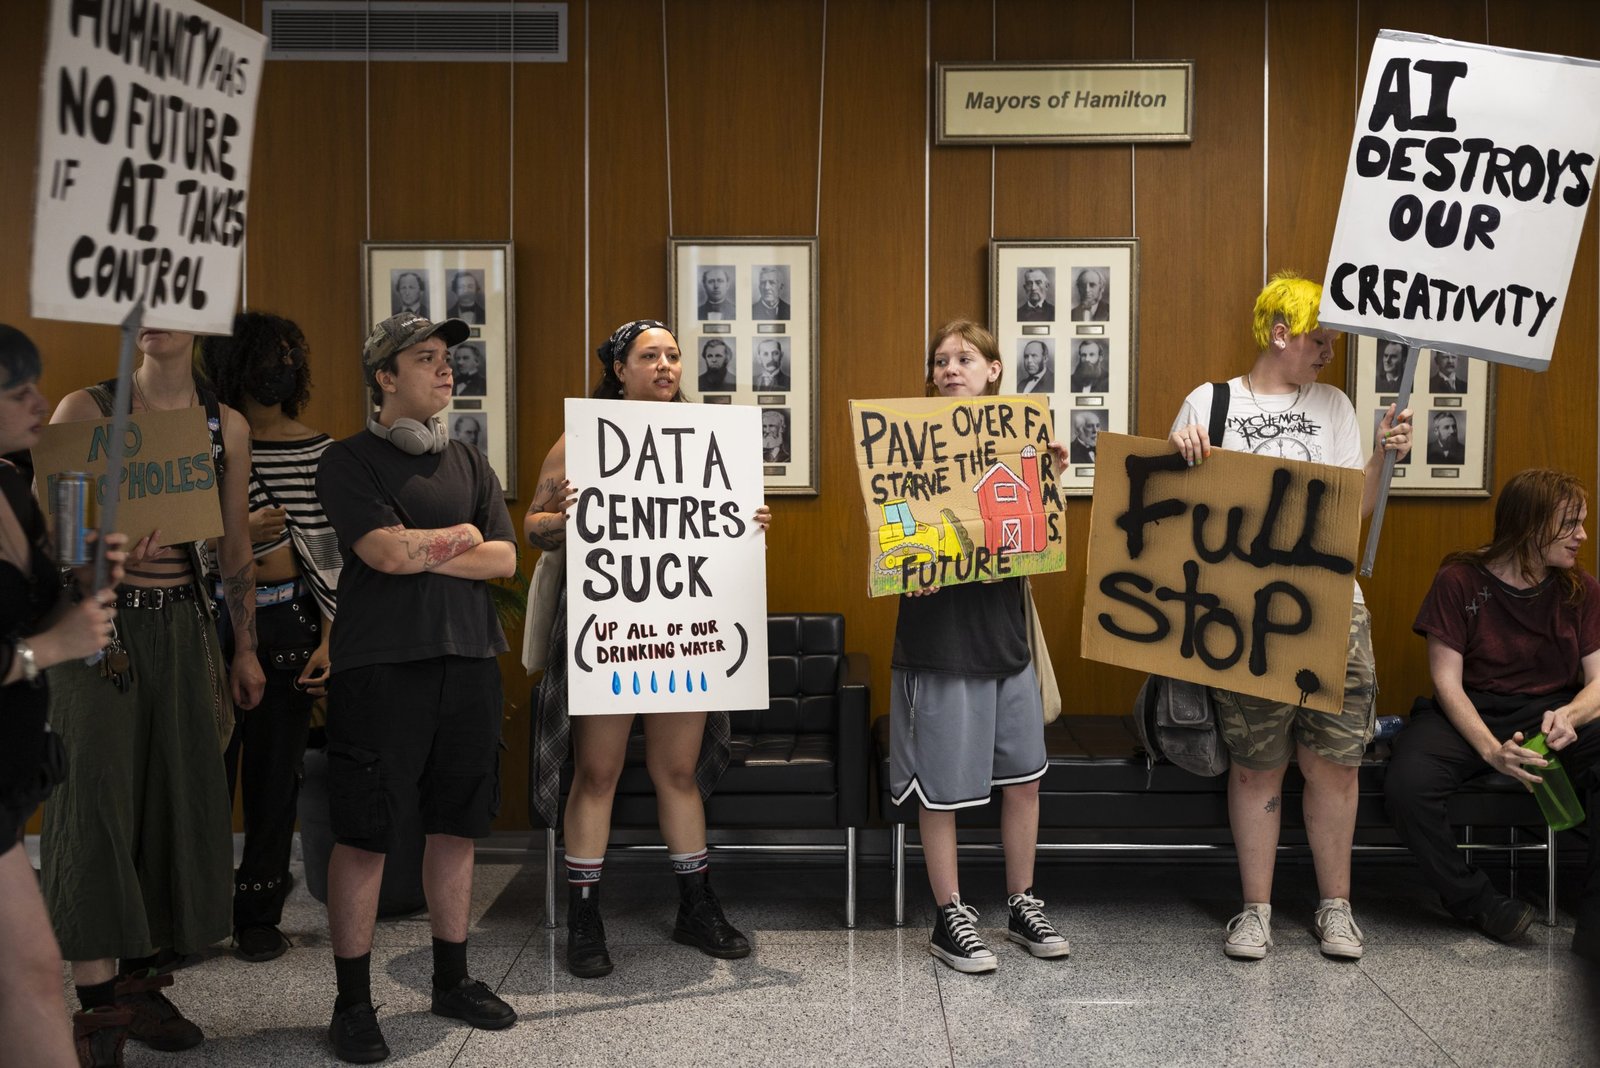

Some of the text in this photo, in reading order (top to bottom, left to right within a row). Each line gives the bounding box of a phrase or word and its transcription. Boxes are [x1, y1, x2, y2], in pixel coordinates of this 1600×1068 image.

[209, 47, 249, 97] HAS
[1368, 57, 1468, 132] AI
[59, 66, 239, 181] NO FUTURE
[965, 90, 1167, 113] Mayors of Hamilton
[51, 159, 80, 200] IF
[108, 157, 166, 241] AI
[1356, 135, 1595, 207] DESTROYS
[1389, 194, 1501, 251] OUR
[68, 235, 208, 310] CONTROL
[1330, 262, 1557, 337] CREATIVITY
[87, 422, 143, 462] NO
[597, 417, 732, 491] DATA
[860, 411, 949, 469] PAVE
[952, 404, 1017, 439] OVER
[1228, 417, 1250, 434] MY
[871, 440, 998, 505] STARVE THE
[576, 487, 746, 543] CENTRES
[582, 547, 713, 603] SUCK
[901, 546, 1012, 590] FUTURE
[596, 641, 676, 664] DRINKING
[627, 623, 658, 640] ALL
[667, 622, 684, 636] OF
[690, 620, 719, 636] OUR
